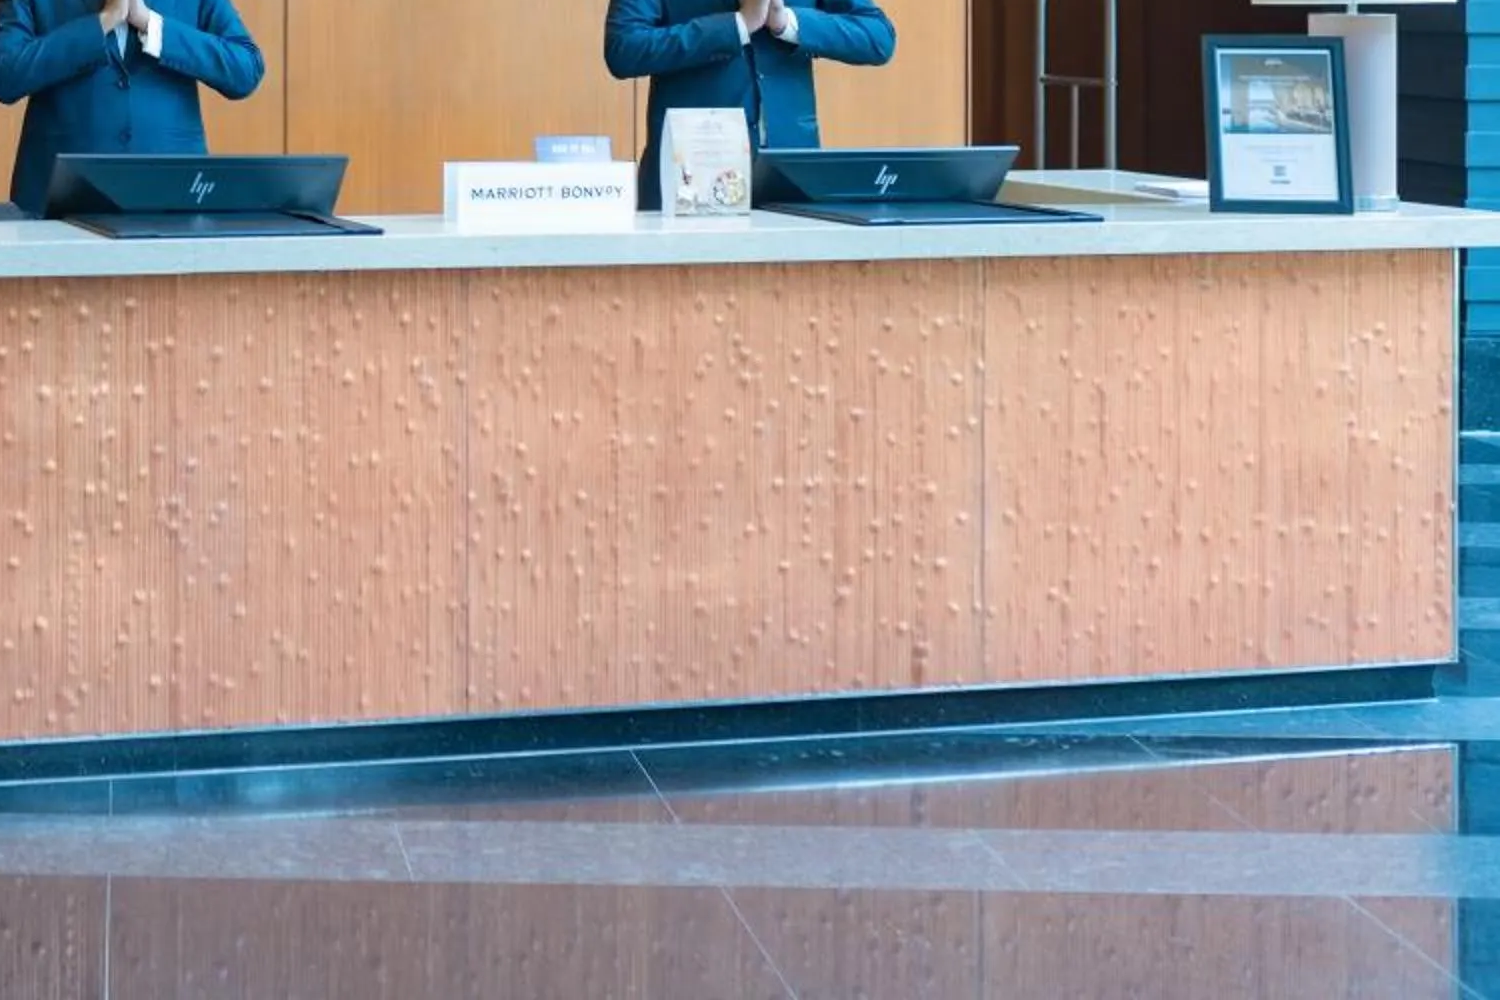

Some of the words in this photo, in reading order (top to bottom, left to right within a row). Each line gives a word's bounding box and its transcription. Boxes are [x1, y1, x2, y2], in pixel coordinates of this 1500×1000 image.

[189, 171, 216, 204] hp
[471, 184, 554, 200] MARRIOTT
[561, 184, 624, 199] BONVOY
[874, 164, 897, 195] hp
